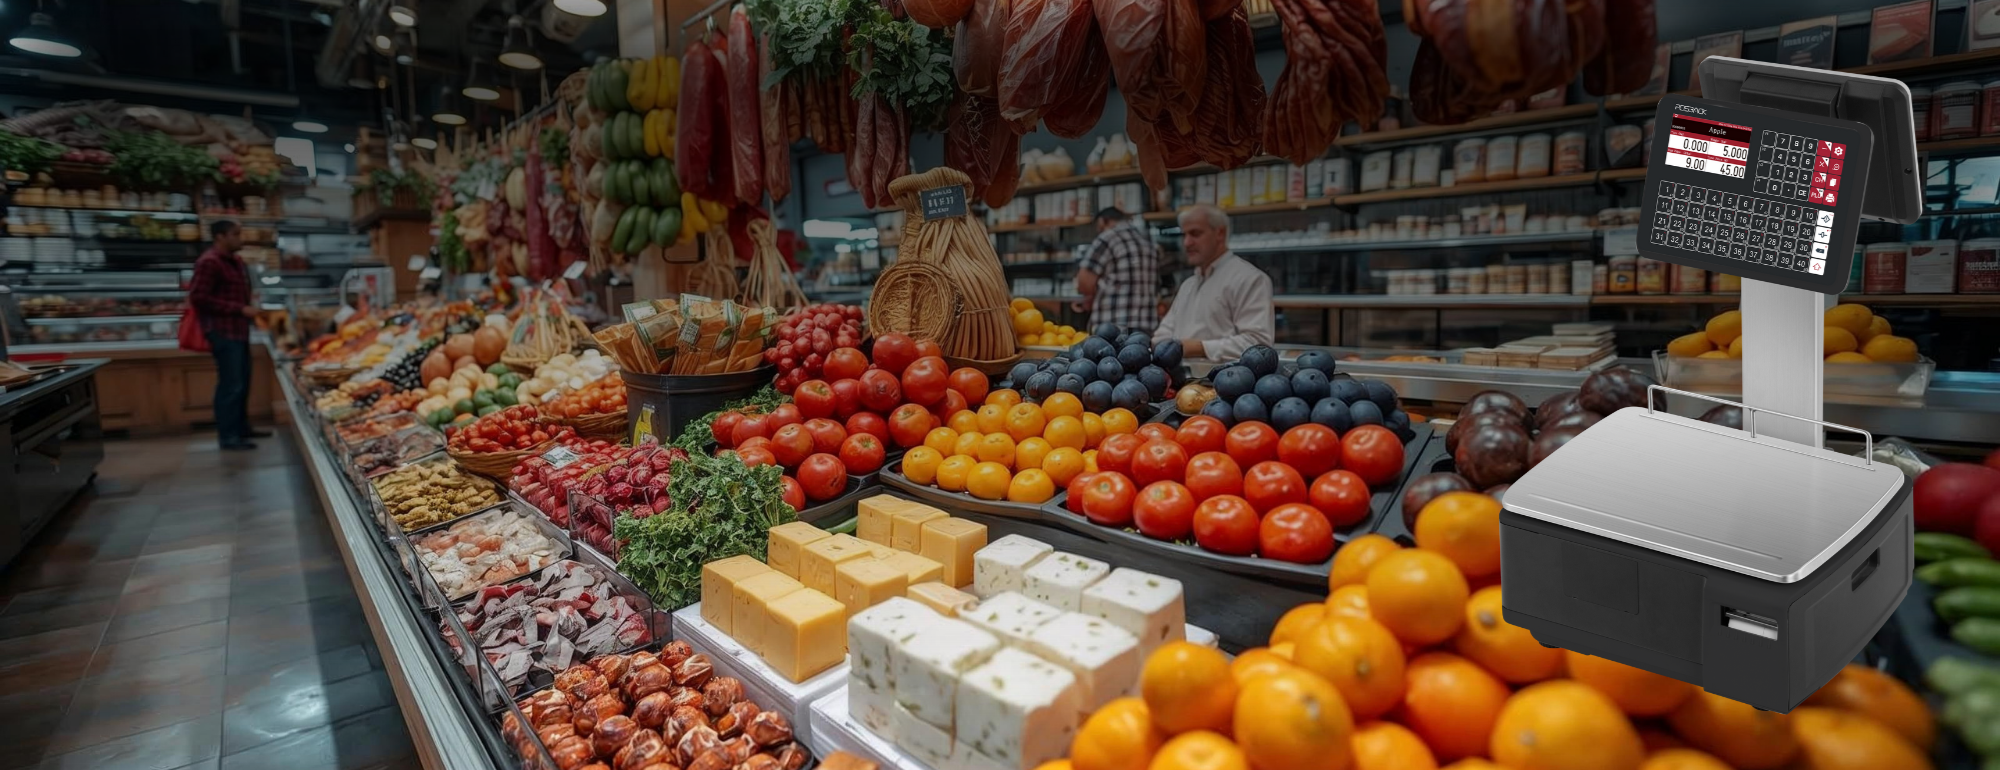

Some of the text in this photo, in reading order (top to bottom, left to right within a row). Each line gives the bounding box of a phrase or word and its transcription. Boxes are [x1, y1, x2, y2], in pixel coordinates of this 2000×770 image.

[1708, 127, 1727, 136] Apple
[1684, 138, 1708, 152] 0.000
[1723, 146, 1748, 160] 5.000
[1686, 157, 1704, 170] 9.00
[1720, 164, 1744, 178] 45.00
[1656, 232, 1663, 240] 31
[1670, 236, 1679, 244] 32
[1686, 238, 1694, 246] 33
[1734, 248, 1742, 256] 36
[1765, 254, 1774, 262] 38
[1780, 256, 1790, 264] 39
